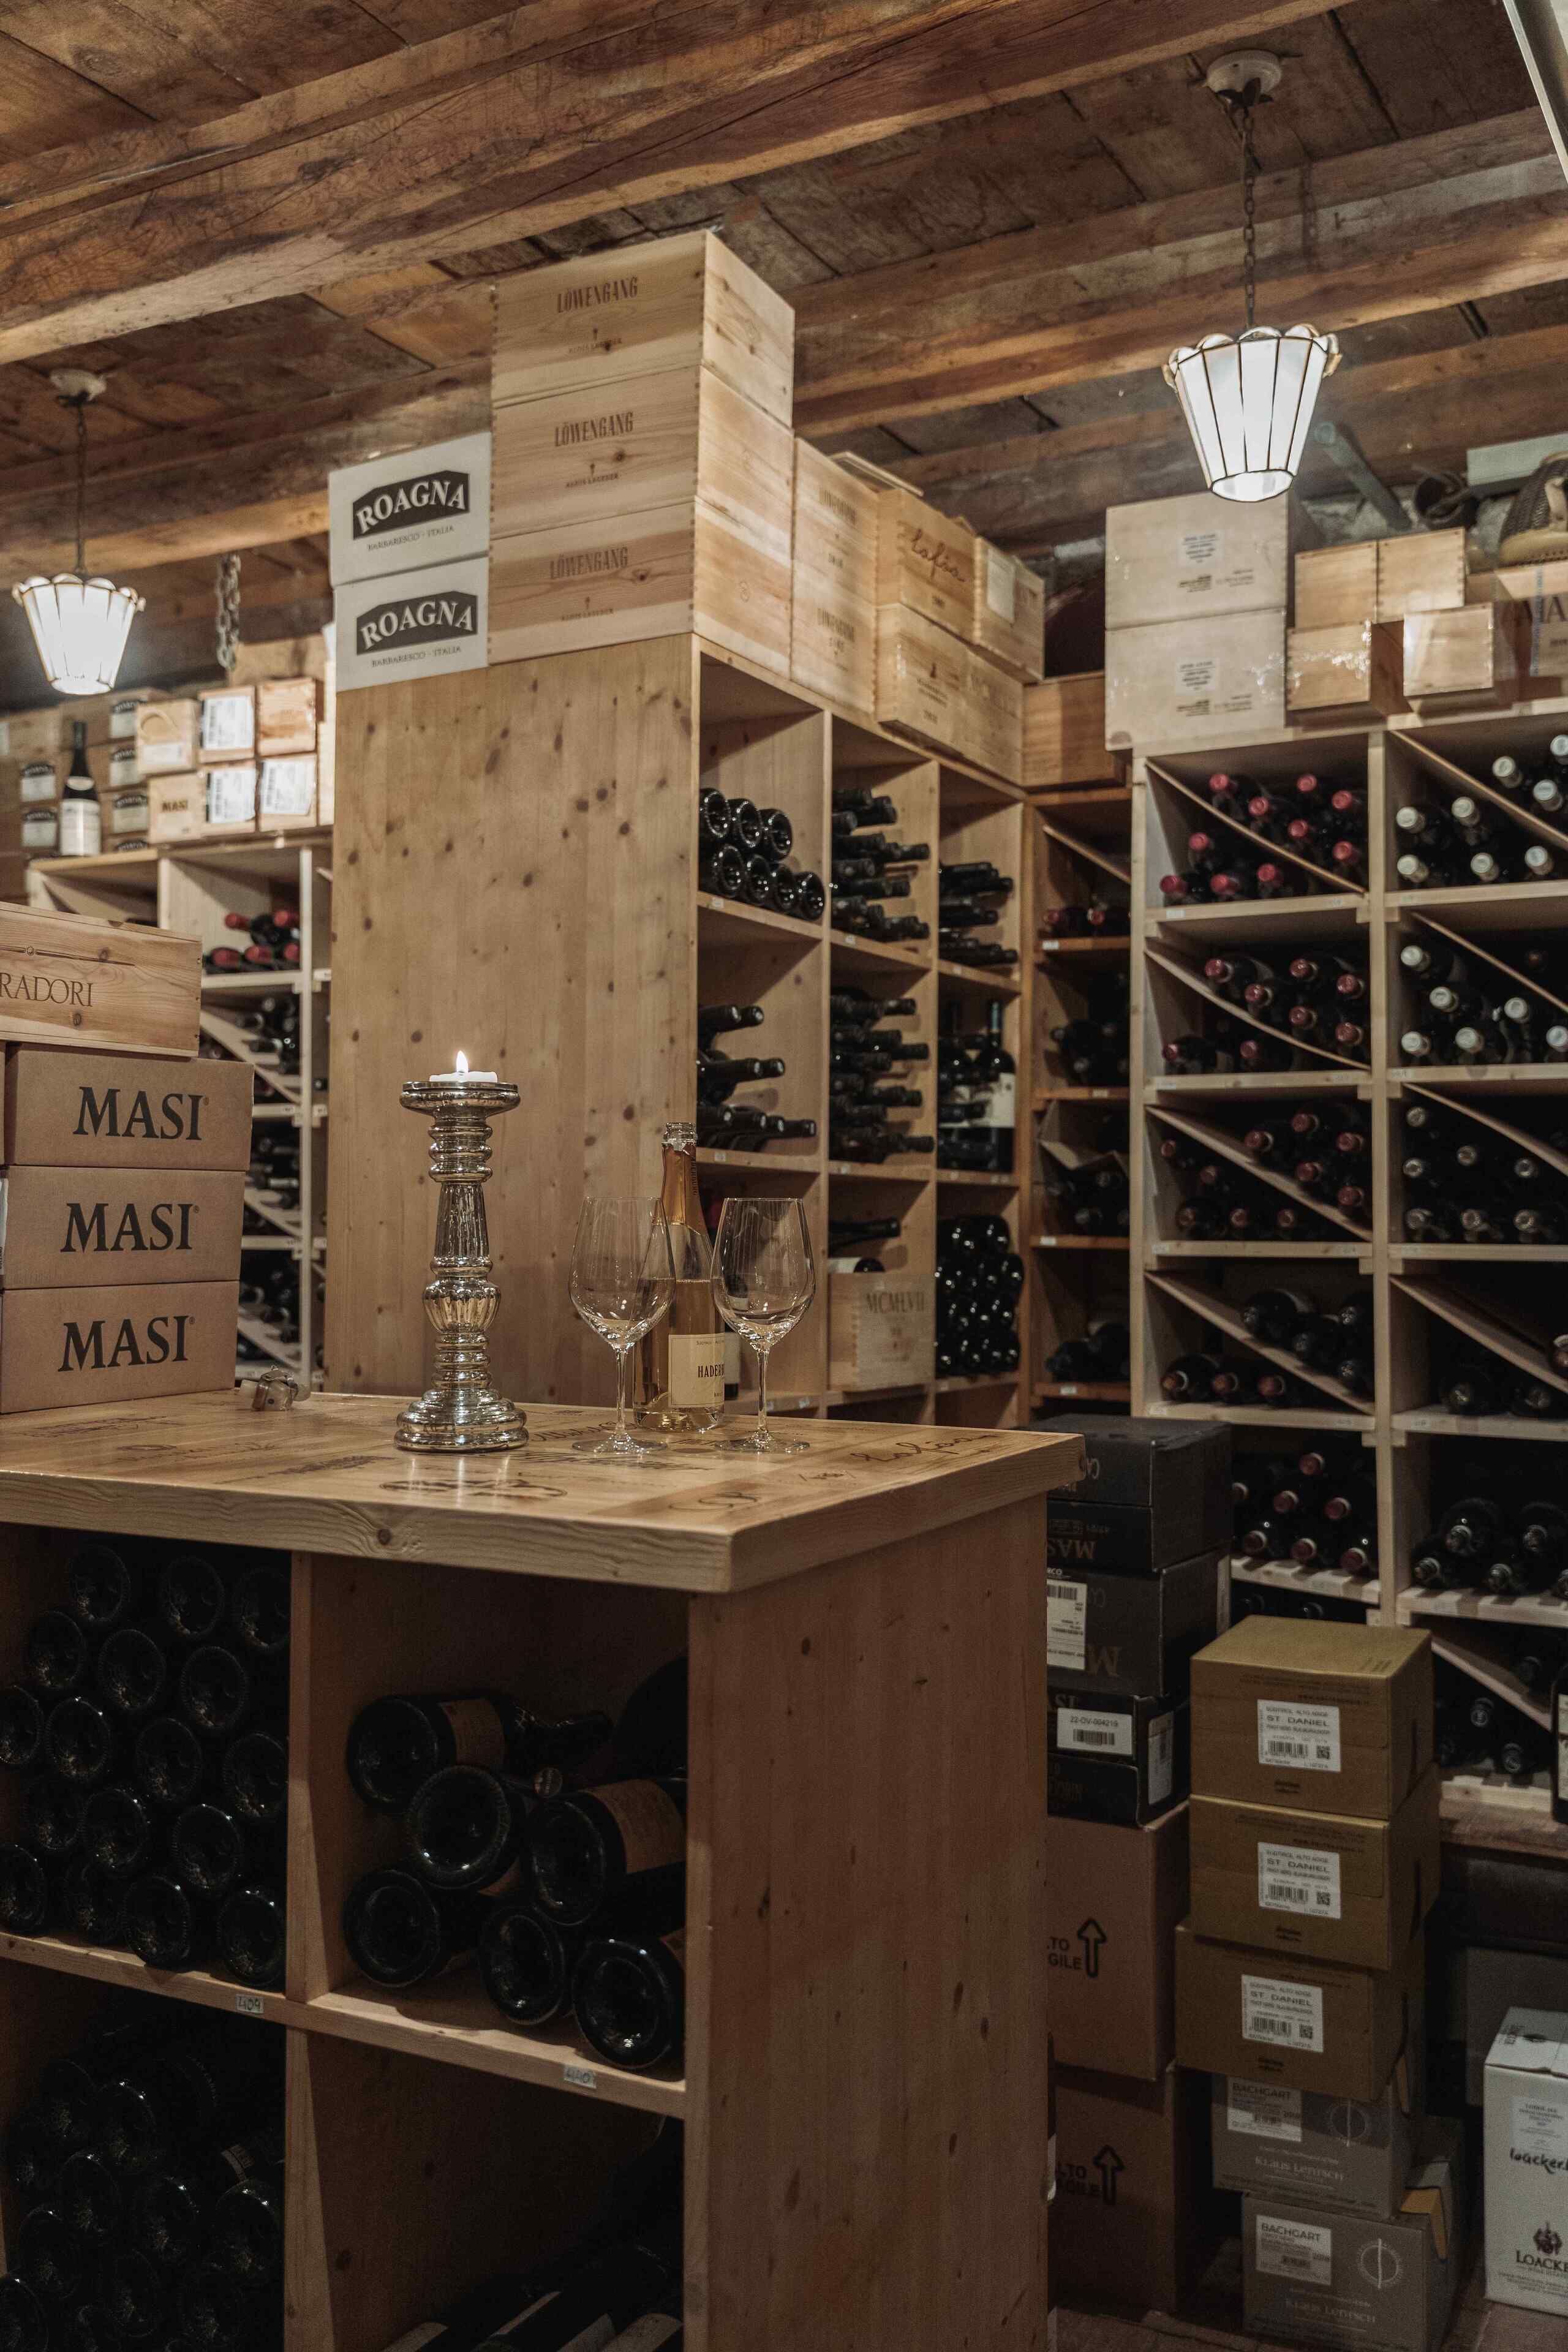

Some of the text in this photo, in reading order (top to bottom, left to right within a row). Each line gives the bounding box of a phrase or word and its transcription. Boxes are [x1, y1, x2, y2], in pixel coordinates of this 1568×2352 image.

[356, 480, 466, 534] ROAGNA
[359, 600, 473, 650] ROAGNA
[372, 651, 426, 667] BARBARESCO
[1287, 1717, 1330, 1727] DANIEL
[1287, 1861, 1330, 1873] DANIEL
[1261, 2222, 1321, 2242] BACHGART
